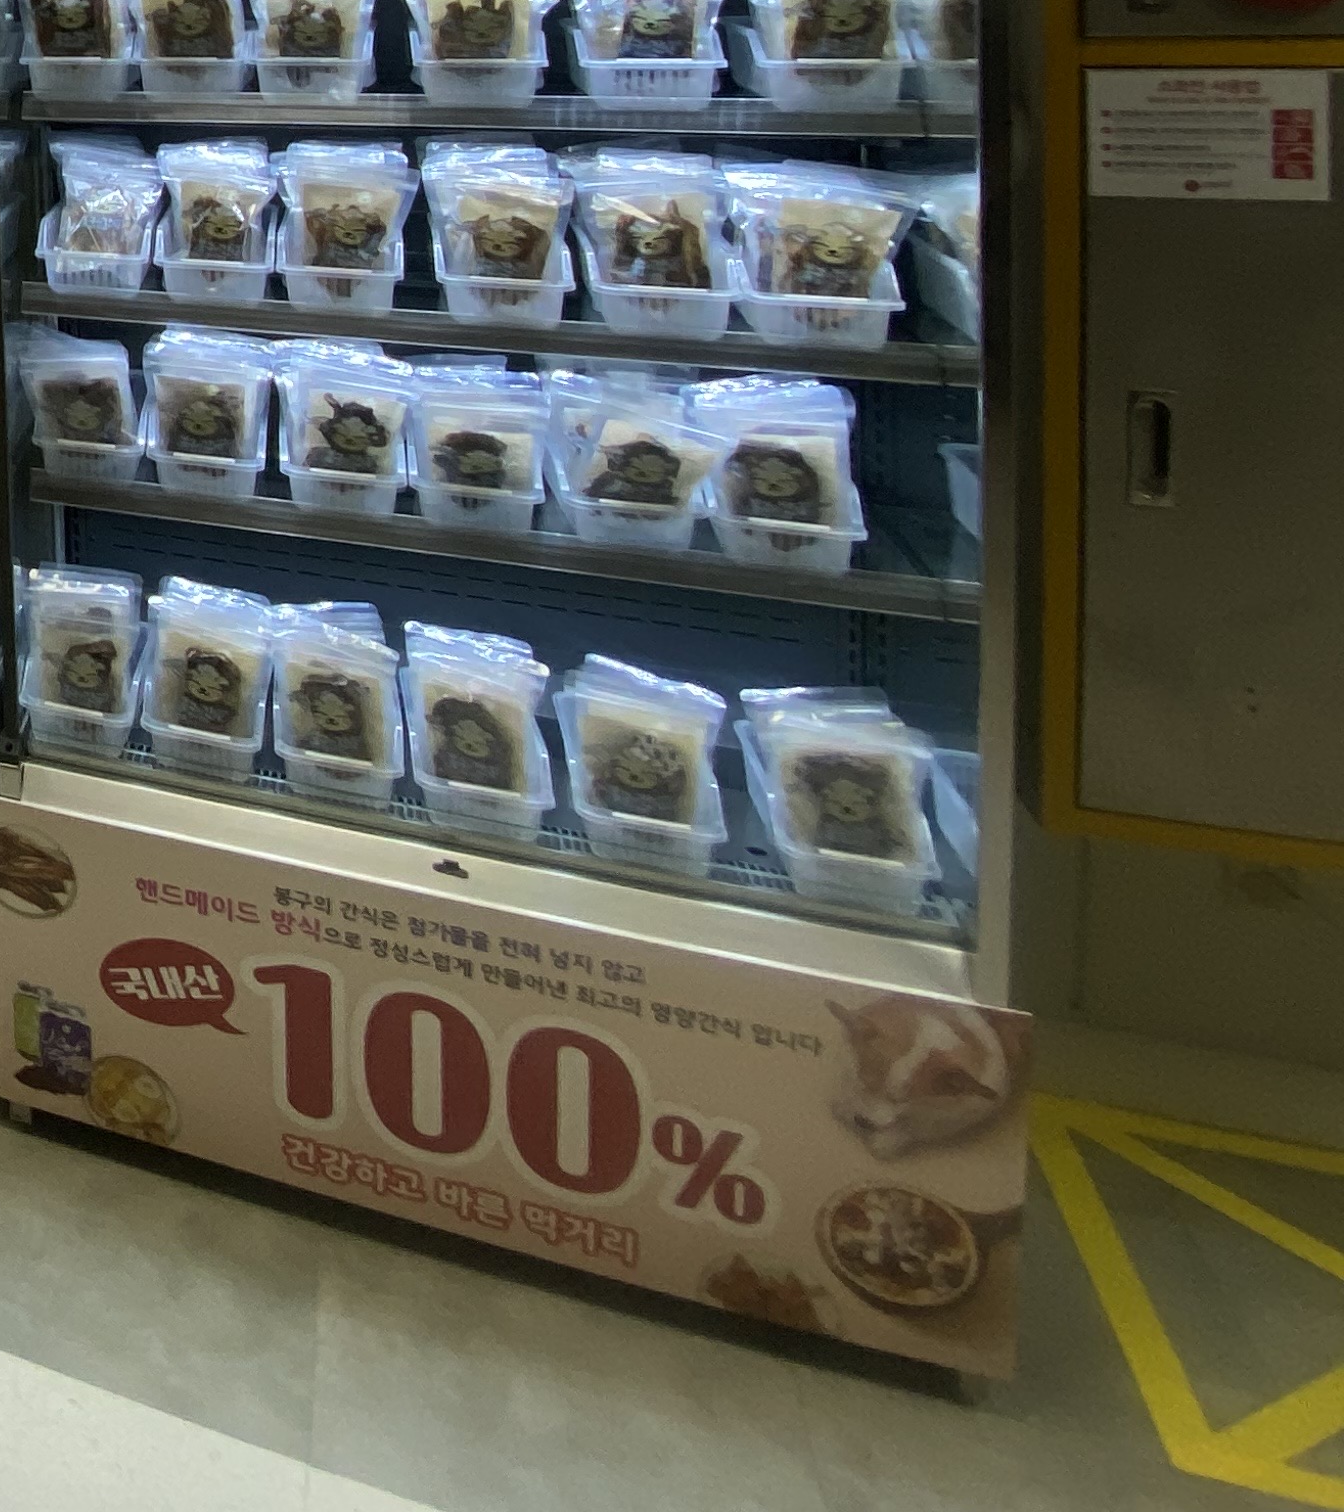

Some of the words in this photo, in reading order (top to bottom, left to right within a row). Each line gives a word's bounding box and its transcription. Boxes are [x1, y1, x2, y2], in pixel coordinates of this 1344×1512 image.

[135, 876, 261, 924] 핸드메이드
[270, 909, 363, 951] 방식으로
[370, 937, 475, 980] 정성스럽게
[576, 985, 642, 1018] 최고의
[650, 1000, 742, 1040] 영양간식
[750, 1022, 825, 1058] 입니다
[273, 886, 332, 916] 봉구의
[339, 899, 400, 930] 간식은
[108, 963, 223, 1002] 국내산
[253, 963, 767, 1228] 100%
[281, 1133, 427, 1204] 건강하고
[433, 1176, 513, 1231] 바른
[519, 1199, 641, 1269] 먹거리
